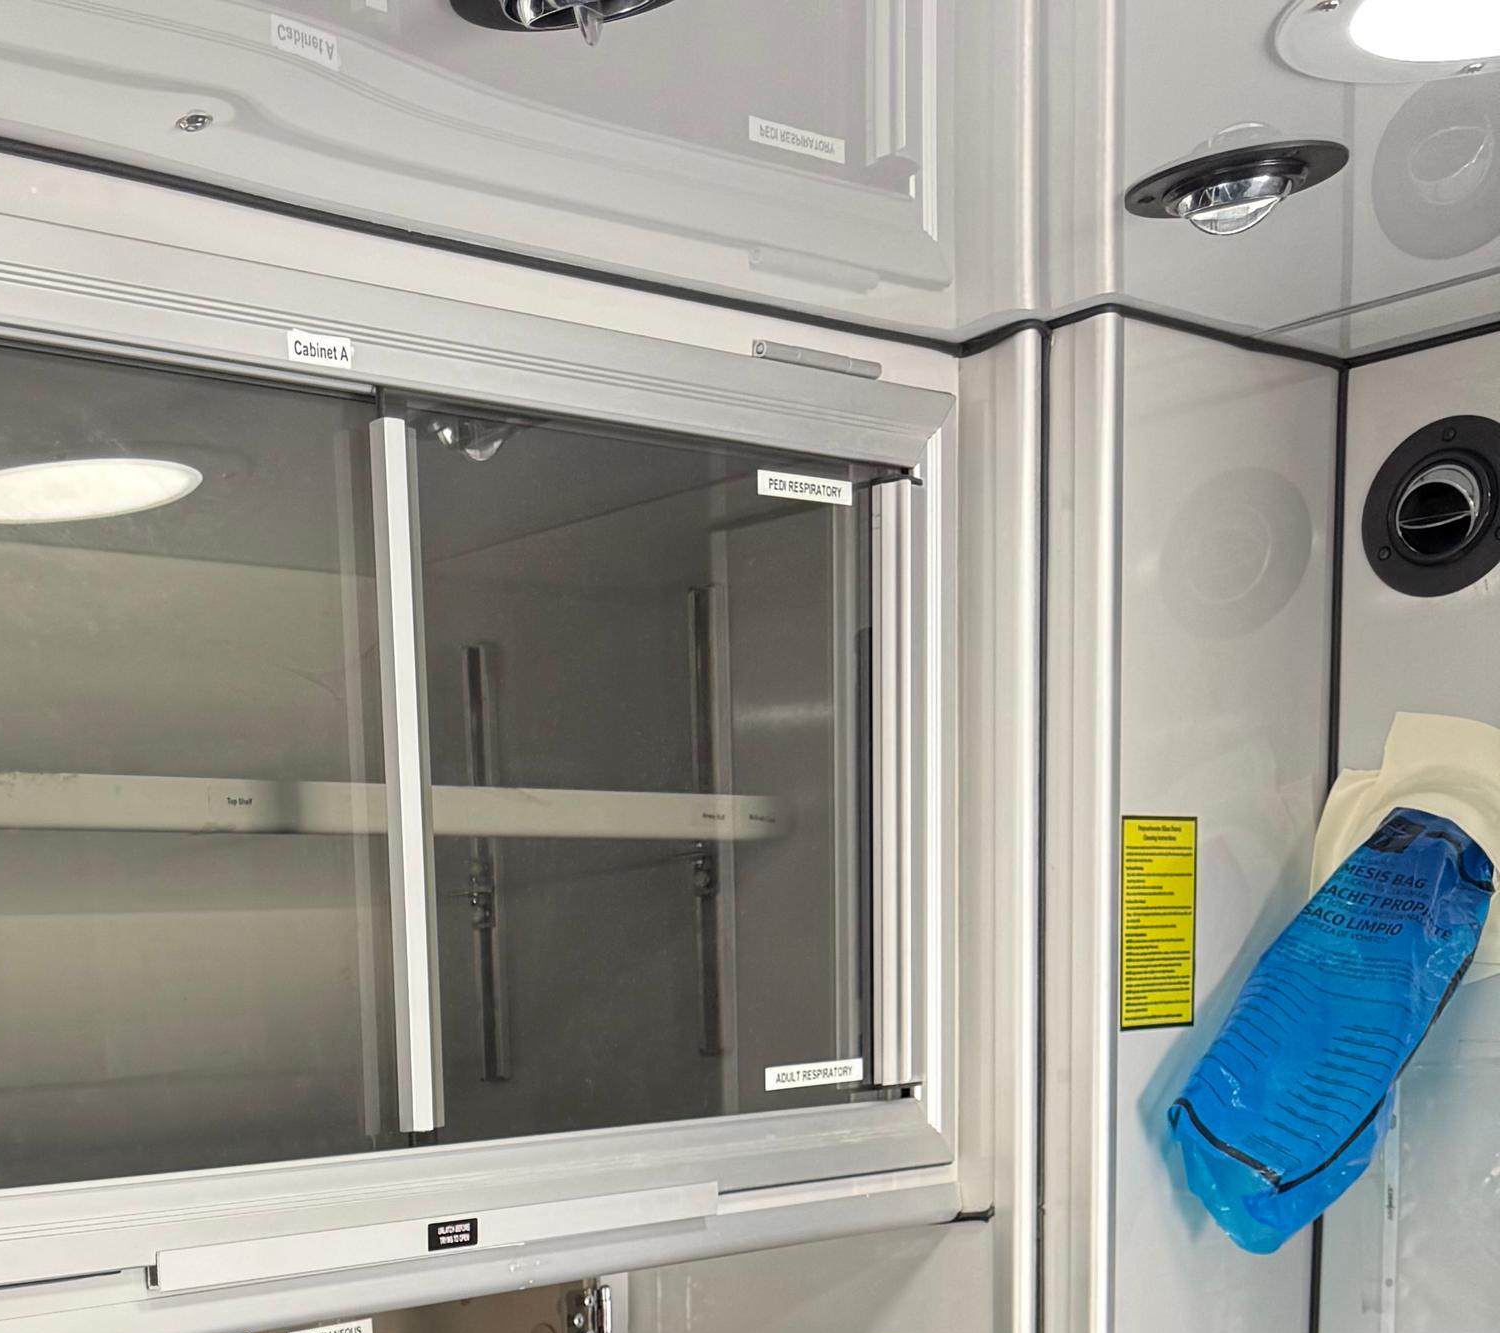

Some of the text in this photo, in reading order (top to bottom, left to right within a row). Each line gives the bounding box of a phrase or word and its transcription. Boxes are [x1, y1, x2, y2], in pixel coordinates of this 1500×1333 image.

[294, 340, 349, 361] Cabinet A
[769, 478, 842, 498] PEDI RESPIRATORY
[1341, 863, 1392, 883] MESIS
[1392, 874, 1428, 889] BAG
[1300, 903, 1345, 926] SACO
[1346, 917, 1403, 936] LIMPIO
[776, 1066, 853, 1083] ADULT RESPIRATORY
